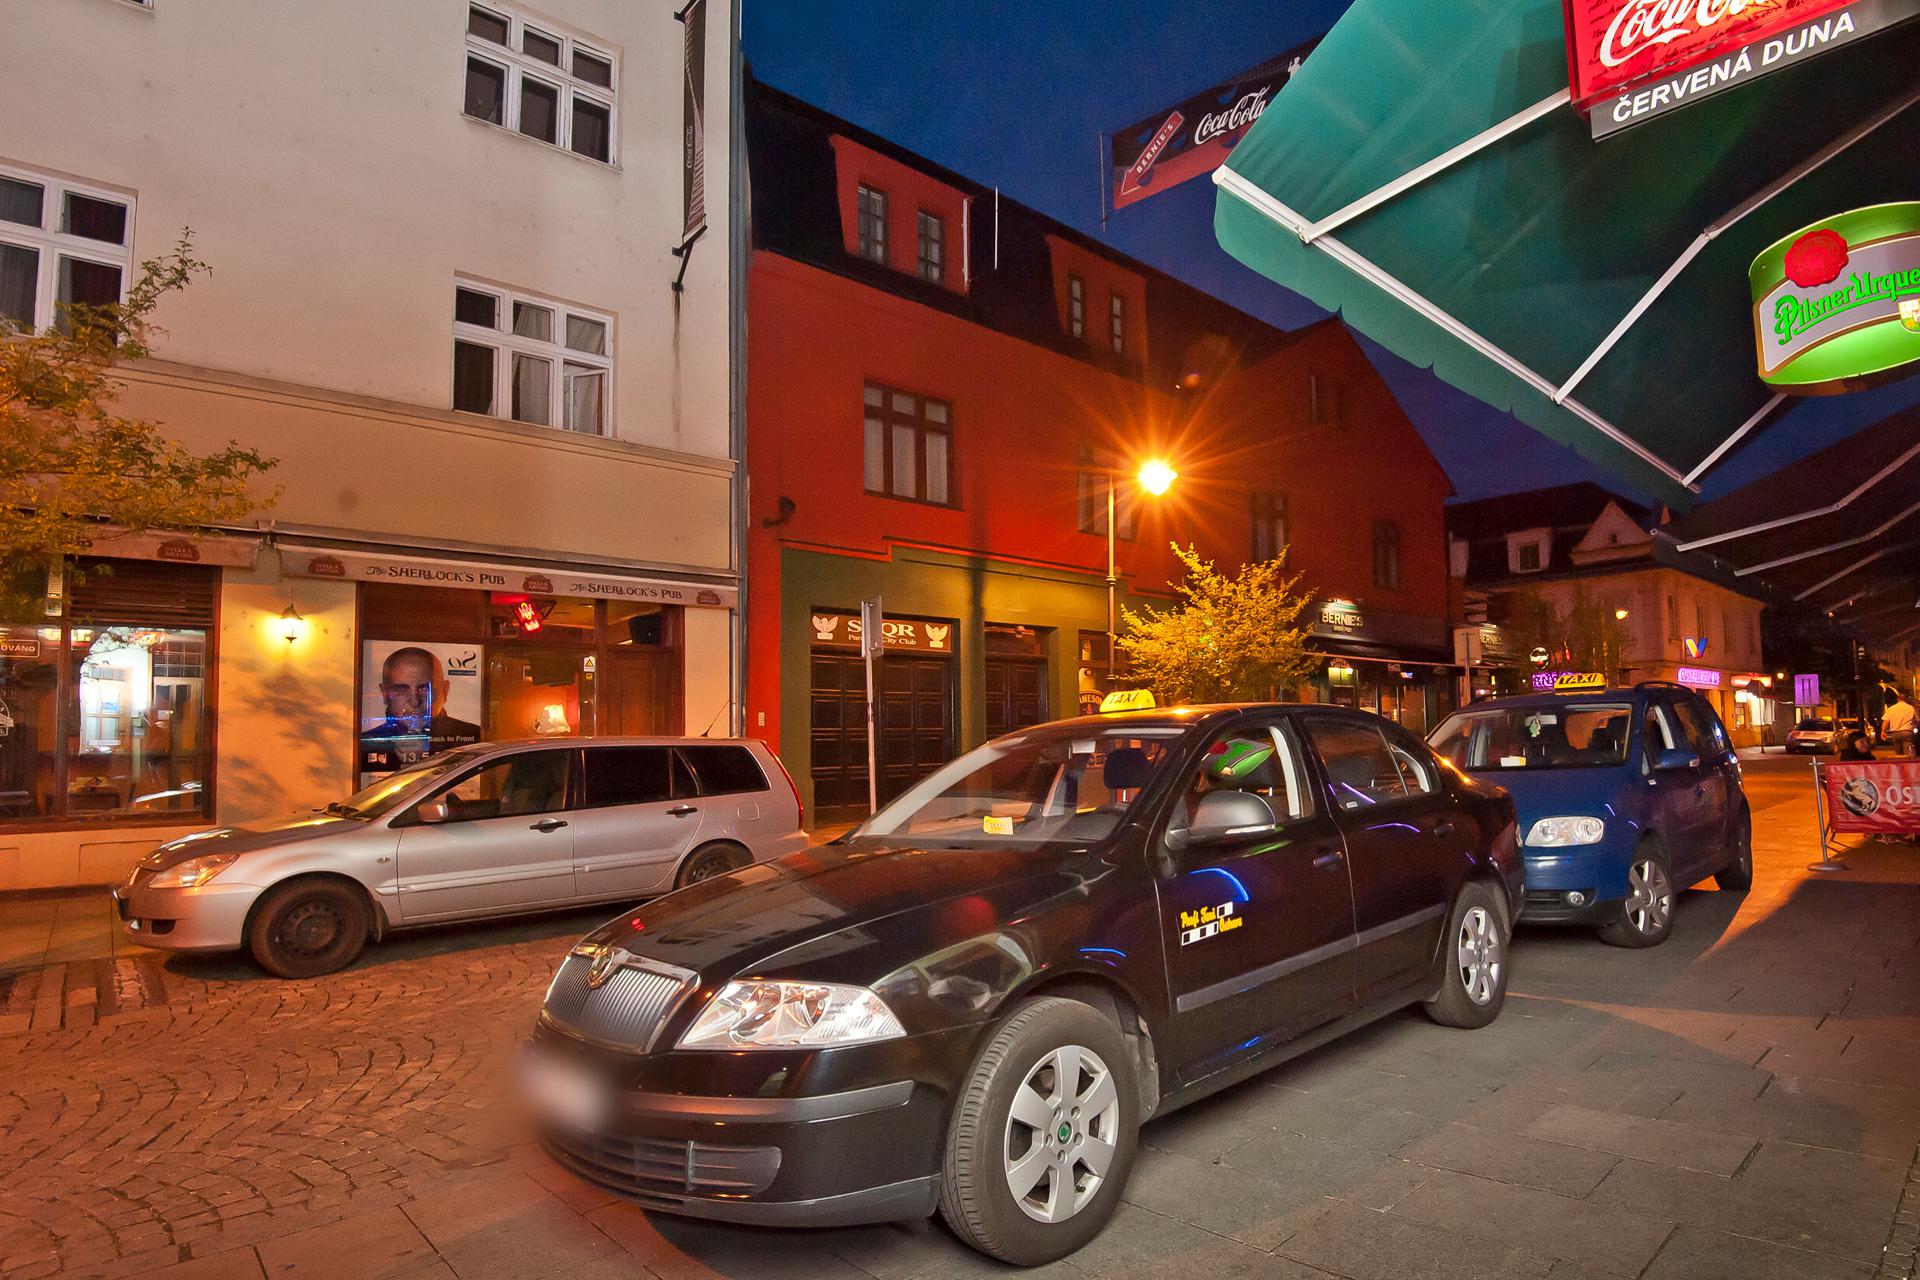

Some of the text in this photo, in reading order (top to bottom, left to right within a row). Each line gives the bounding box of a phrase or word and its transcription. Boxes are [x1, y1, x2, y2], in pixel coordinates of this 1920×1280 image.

[1612, 46, 1752, 122] ČERVENÁ
[1761, 12, 1855, 66] DUNA
[1135, 123, 1174, 174] BERNIE'S
[1774, 284, 1854, 345] Pilsner
[479, 573, 505, 585] PUB
[661, 588, 682, 600] PUB
[848, 619, 916, 638] SQR
[898, 638, 917, 646] Club
[1559, 673, 1599, 685] TAXI
[1109, 691, 1141, 705] TAXI
